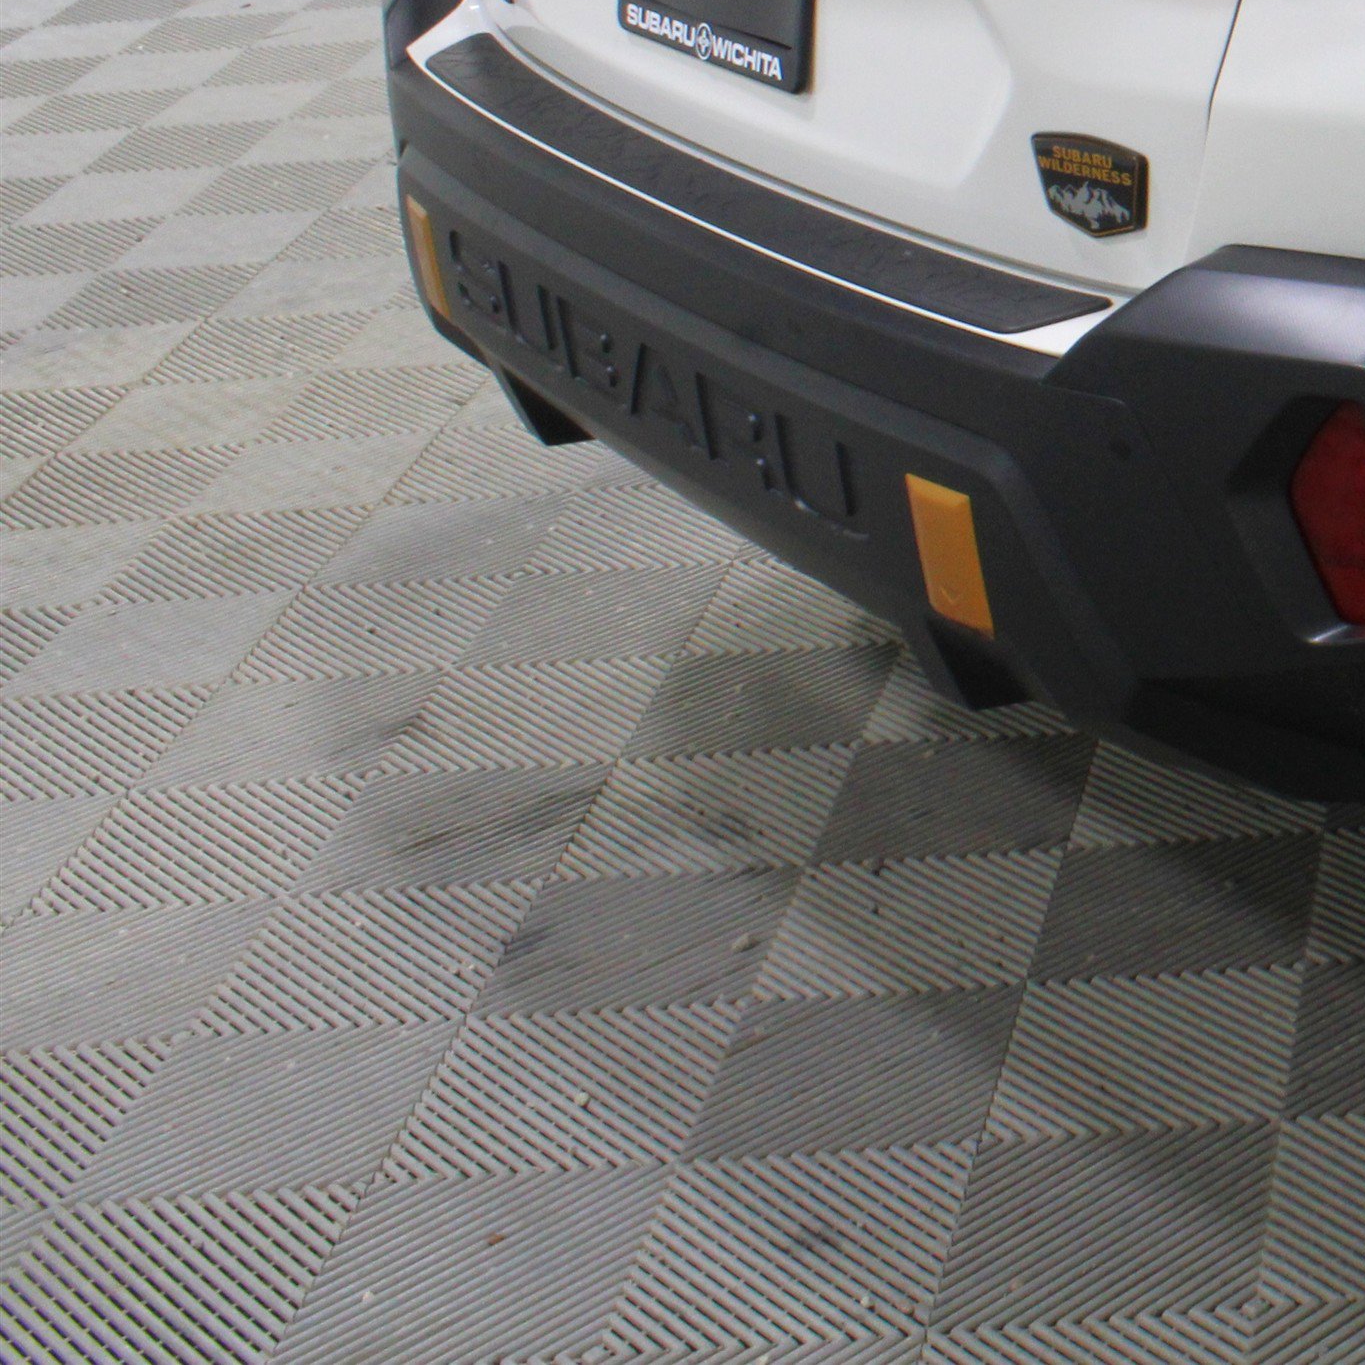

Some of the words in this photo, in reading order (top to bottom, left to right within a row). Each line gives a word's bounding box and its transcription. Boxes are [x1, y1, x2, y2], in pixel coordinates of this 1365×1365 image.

[626, 3, 695, 47] SUBARU
[711, 35, 782, 80] WICHITA
[1038, 155, 1132, 186] WILDERNESS
[1053, 146, 1112, 169] SUBARU
[449, 229, 868, 539] SUBARU
